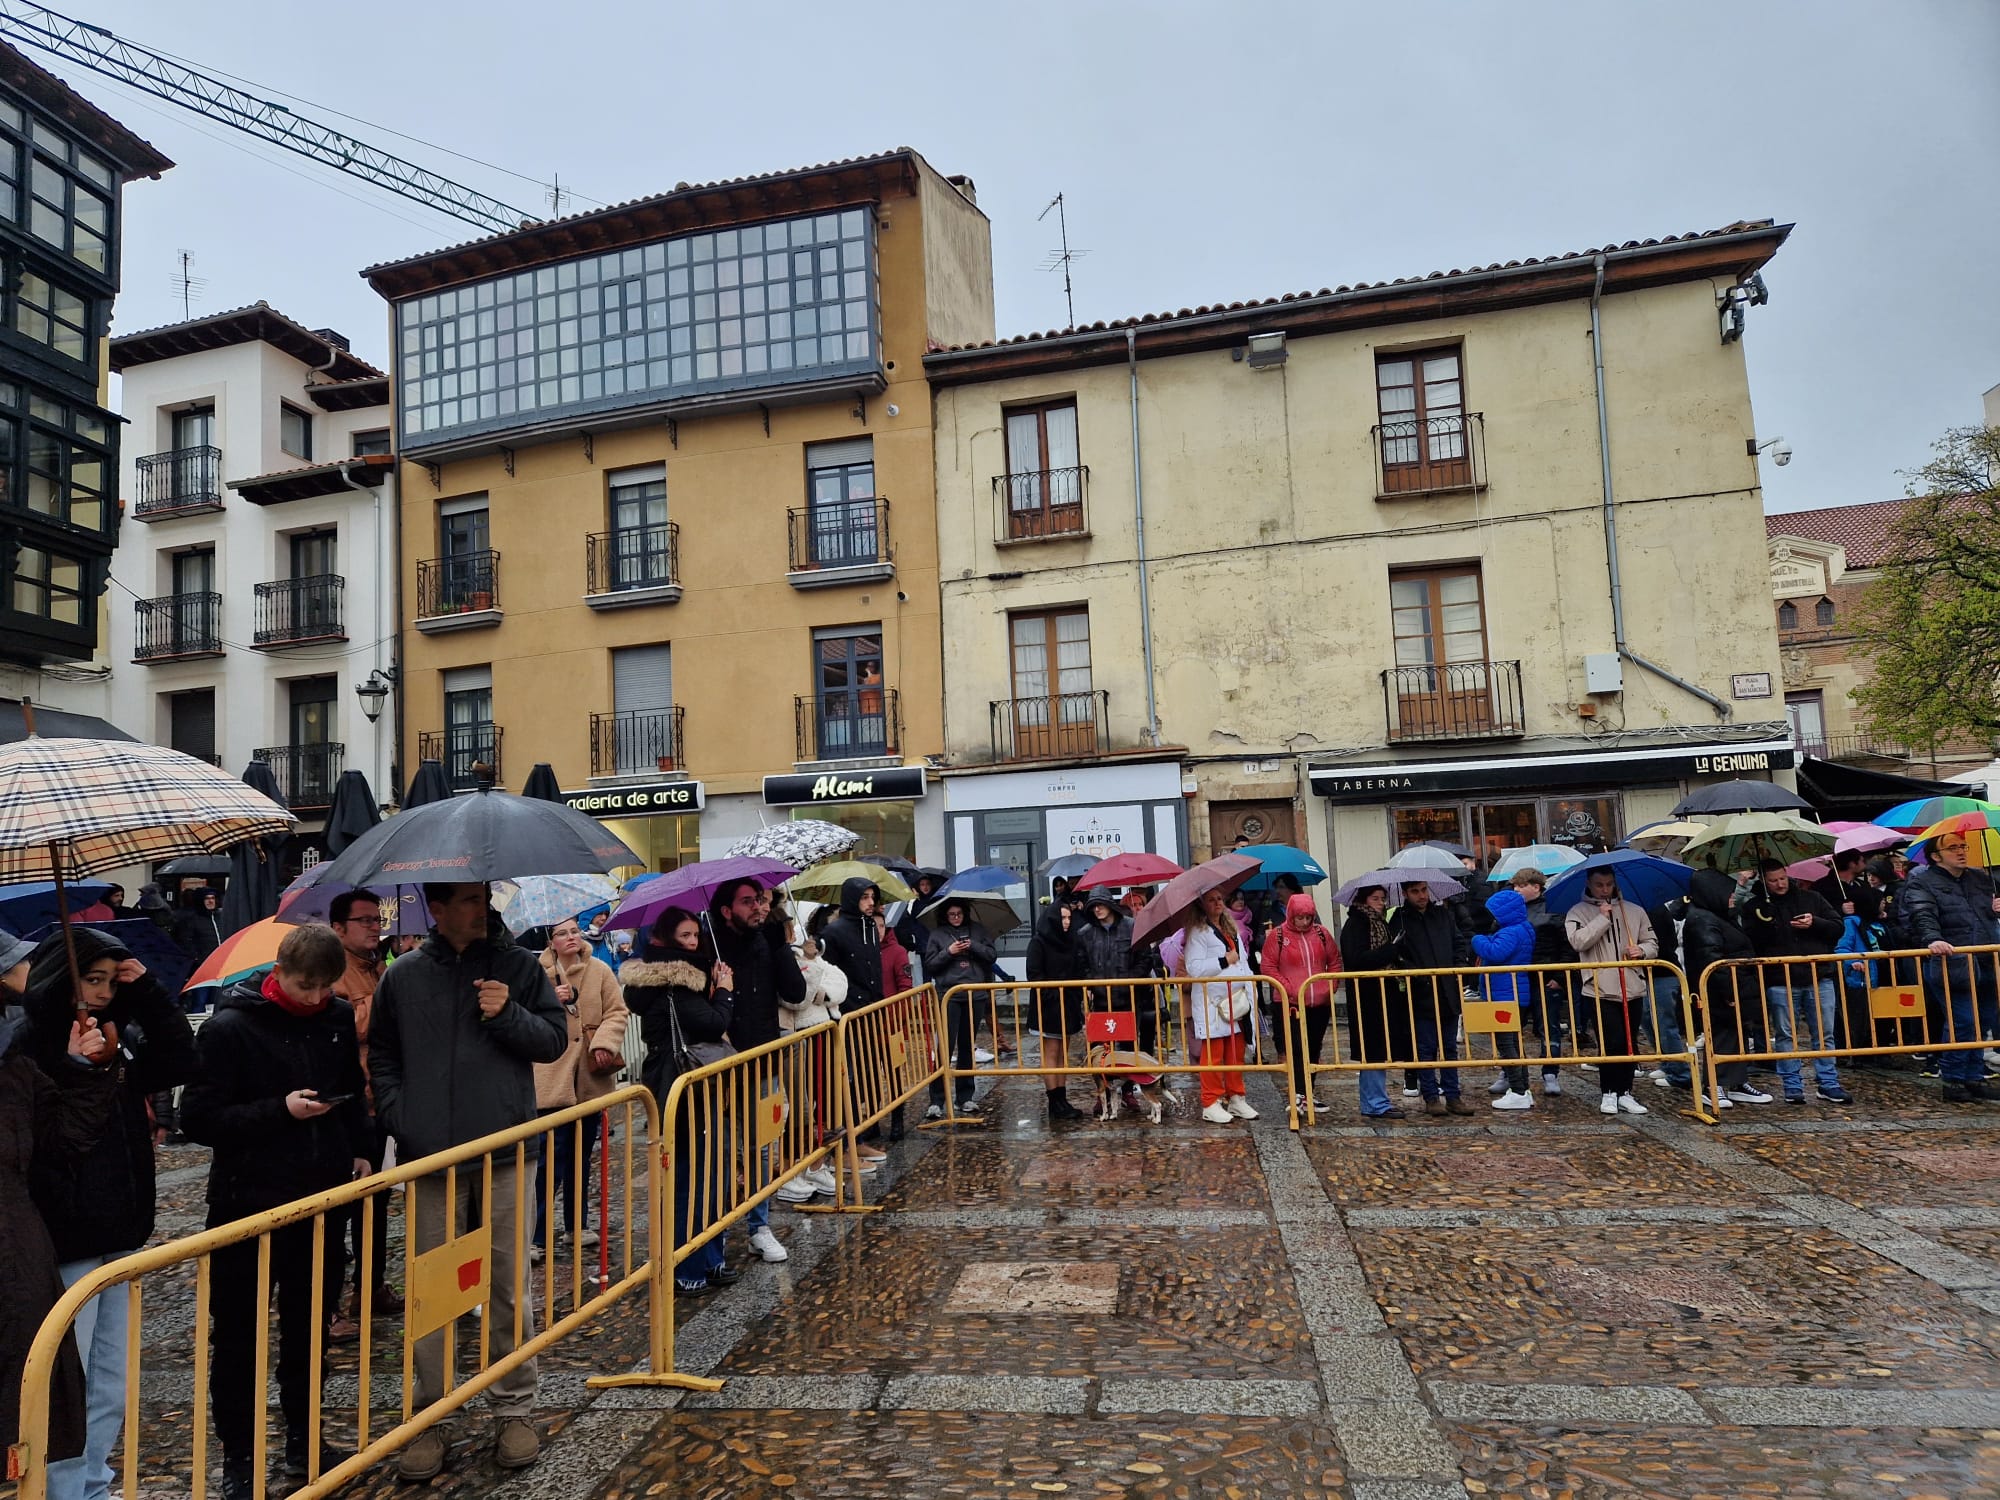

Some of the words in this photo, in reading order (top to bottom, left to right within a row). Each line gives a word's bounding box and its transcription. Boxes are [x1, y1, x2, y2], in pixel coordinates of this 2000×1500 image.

[1246, 764, 1256, 772] 12
[1695, 757, 1709, 770] LA
[1712, 753, 1769, 772] GENUINA
[1333, 778, 1412, 791] TABERNA
[626, 791, 649, 807] de
[653, 788, 689, 804] arte
[1070, 833, 1121, 846] COMPRO
